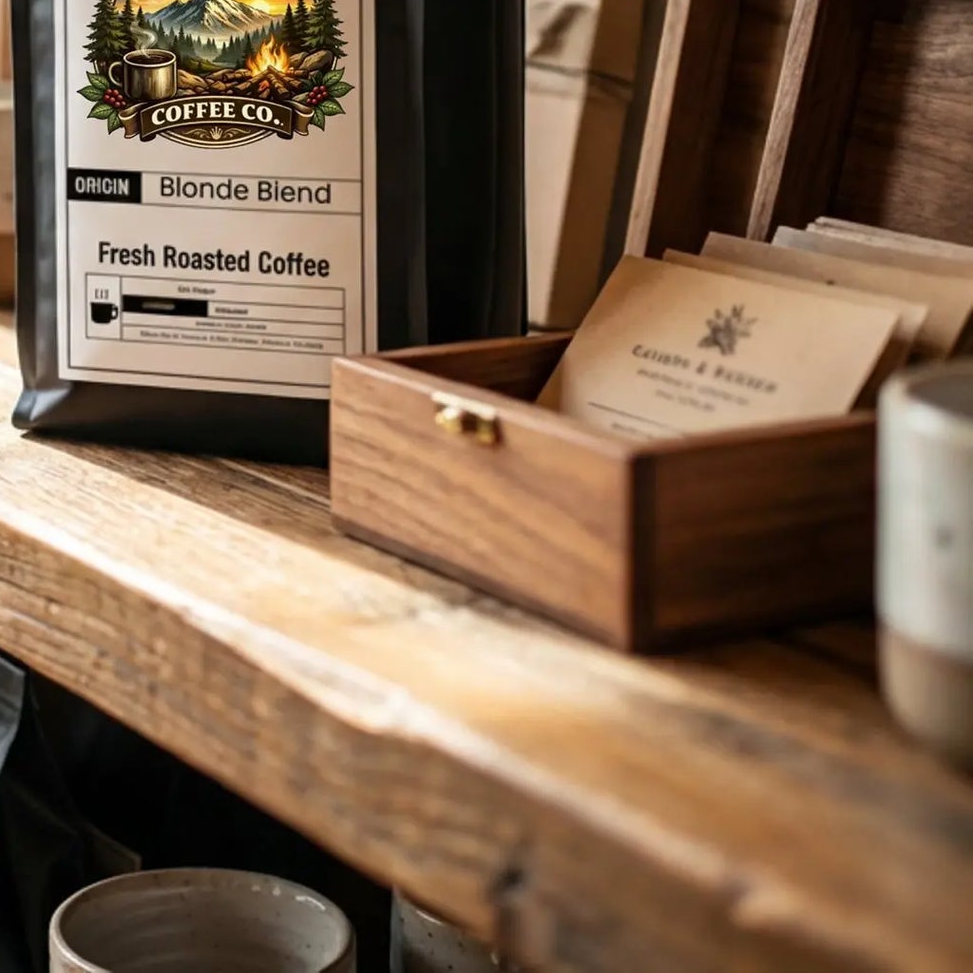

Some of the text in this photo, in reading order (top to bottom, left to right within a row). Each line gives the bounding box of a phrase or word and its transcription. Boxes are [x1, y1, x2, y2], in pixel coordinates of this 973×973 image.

[151, 101, 281, 125] COFFEE CO.
[75, 176, 130, 196] ORIGIN
[160, 176, 249, 201] Blonde
[98, 241, 331, 278] Fresh Roasted Coffee
